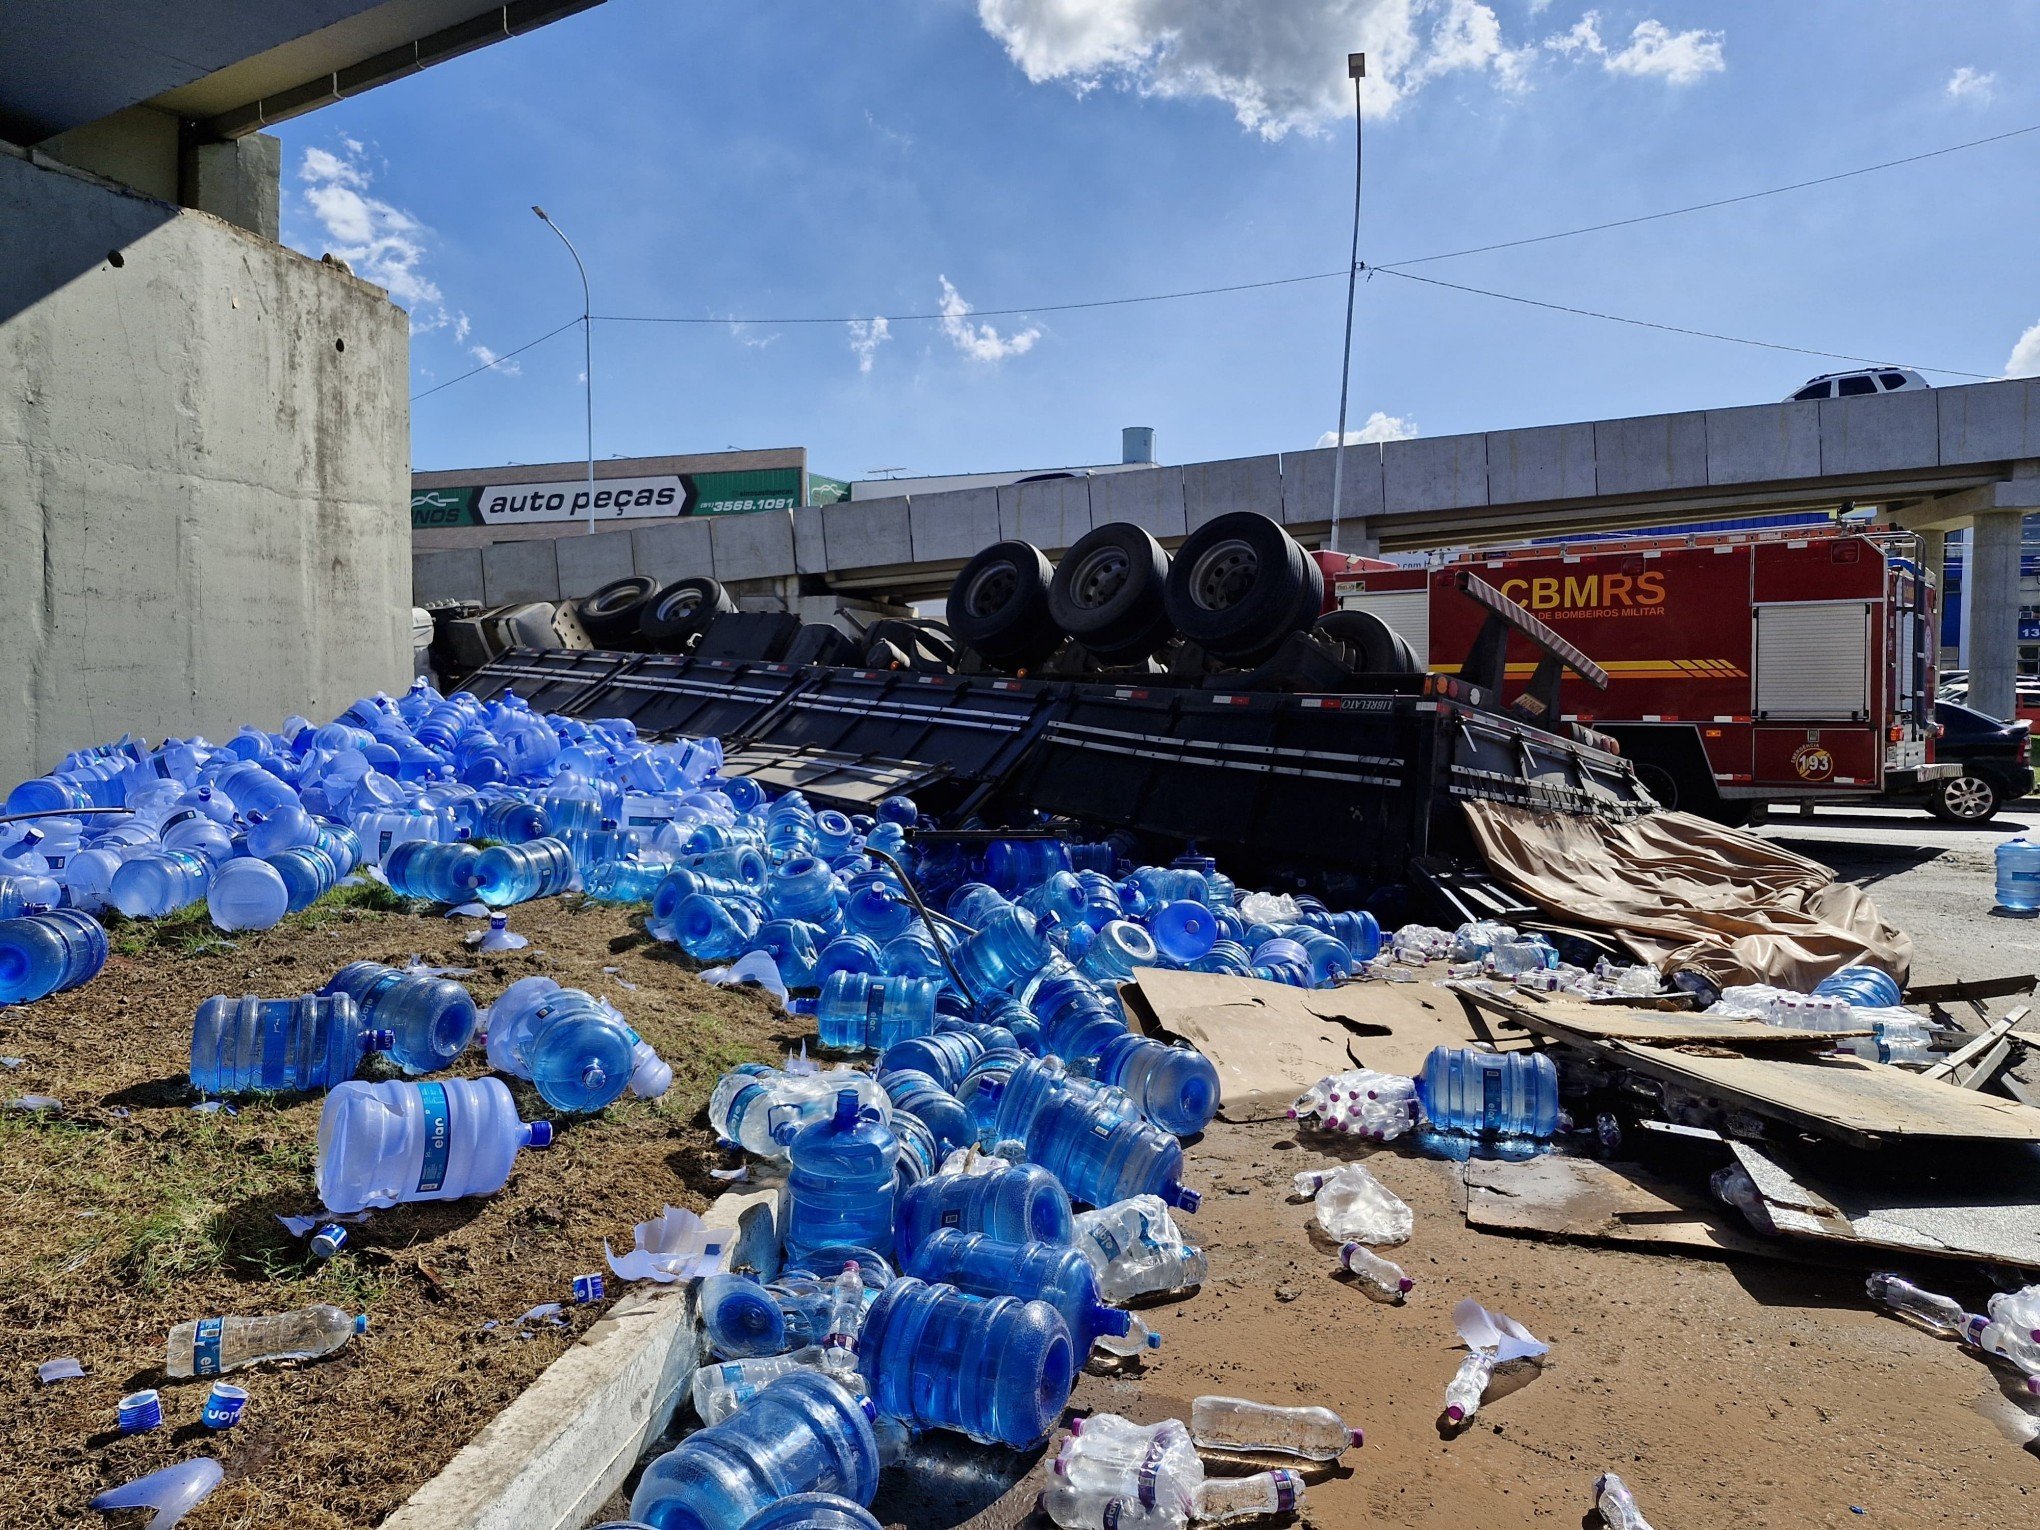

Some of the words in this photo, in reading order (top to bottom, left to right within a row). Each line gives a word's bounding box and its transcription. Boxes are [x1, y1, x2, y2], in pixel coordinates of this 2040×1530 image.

[489, 491, 565, 514] auto
[569, 487, 676, 516] peças
[713, 498, 794, 512] 3568.1091
[412, 508, 461, 524] NOS
[1500, 571, 1666, 609] CBMRS
[1539, 611, 1552, 620] DE
[1555, 609, 1619, 619] BOMBEIROS
[1621, 606, 1664, 617] MILITAR
[1341, 700, 1393, 710] LIBRELATO
[1799, 755, 1829, 771] 193
[384, 1029, 394, 1048] elan
[1487, 1102, 1498, 1121] elan
[431, 1117, 444, 1149] elan
[1105, 1501, 1119, 1527] elan
